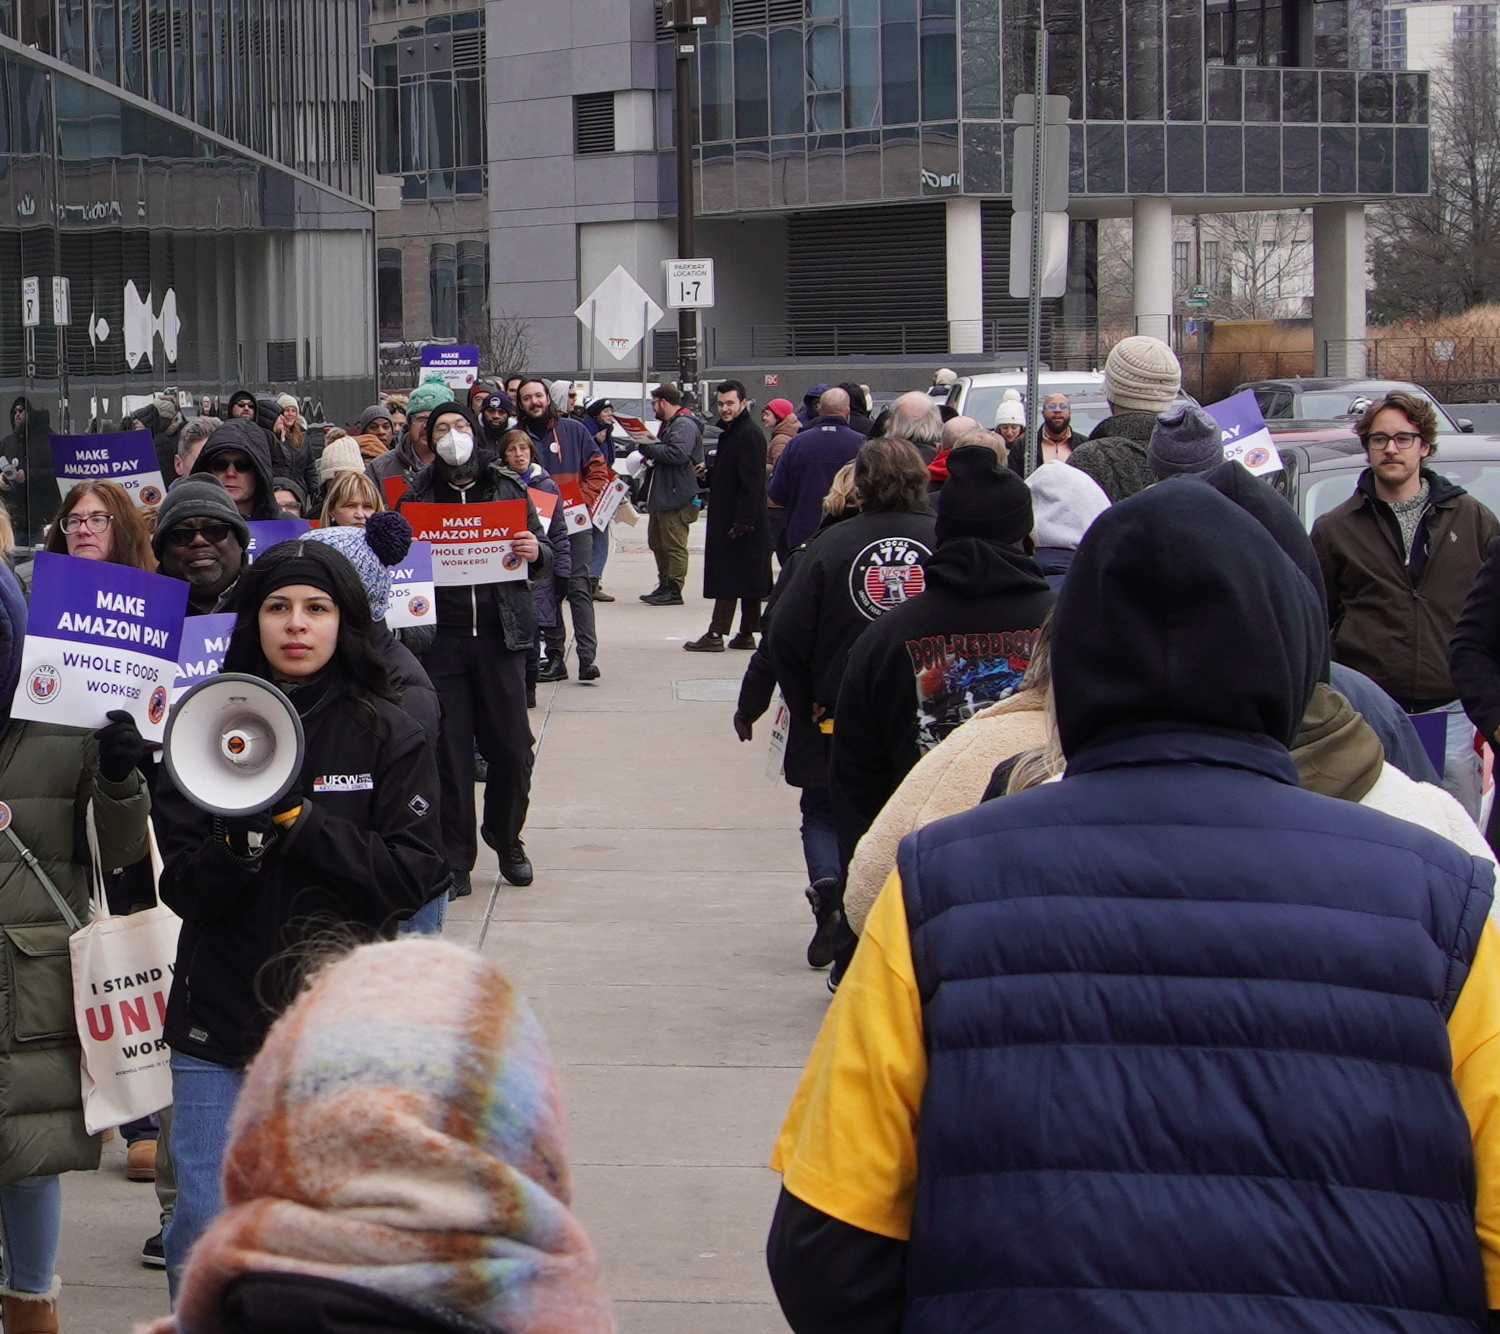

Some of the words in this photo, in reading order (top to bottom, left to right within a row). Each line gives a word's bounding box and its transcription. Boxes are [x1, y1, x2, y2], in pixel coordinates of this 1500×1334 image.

[1221, 424, 1240, 441] AY
[75, 448, 110, 461] MAKE
[64, 463, 109, 475] AMAZON
[112, 459, 139, 473] PAY
[442, 516, 482, 527] MAKE
[419, 529, 480, 540] AMAZON
[482, 527, 510, 538] PAY
[468, 546, 506, 556] FOODS
[879, 540, 909, 548] LOCAL
[441, 557, 489, 567] WORKERS!
[869, 547, 920, 566] 1776
[881, 567, 909, 577] UFCW
[96, 590, 146, 617] MAKE
[57, 612, 141, 643] AMAZON
[143, 626, 169, 650] PAY
[63, 652, 121, 675] WHOLE
[126, 661, 159, 683] FOODS
[87, 680, 141, 700] WORKERS!
[322, 774, 358, 786] UFCW
[91, 983, 98, 996] I
[103, 967, 163, 994] STAND
